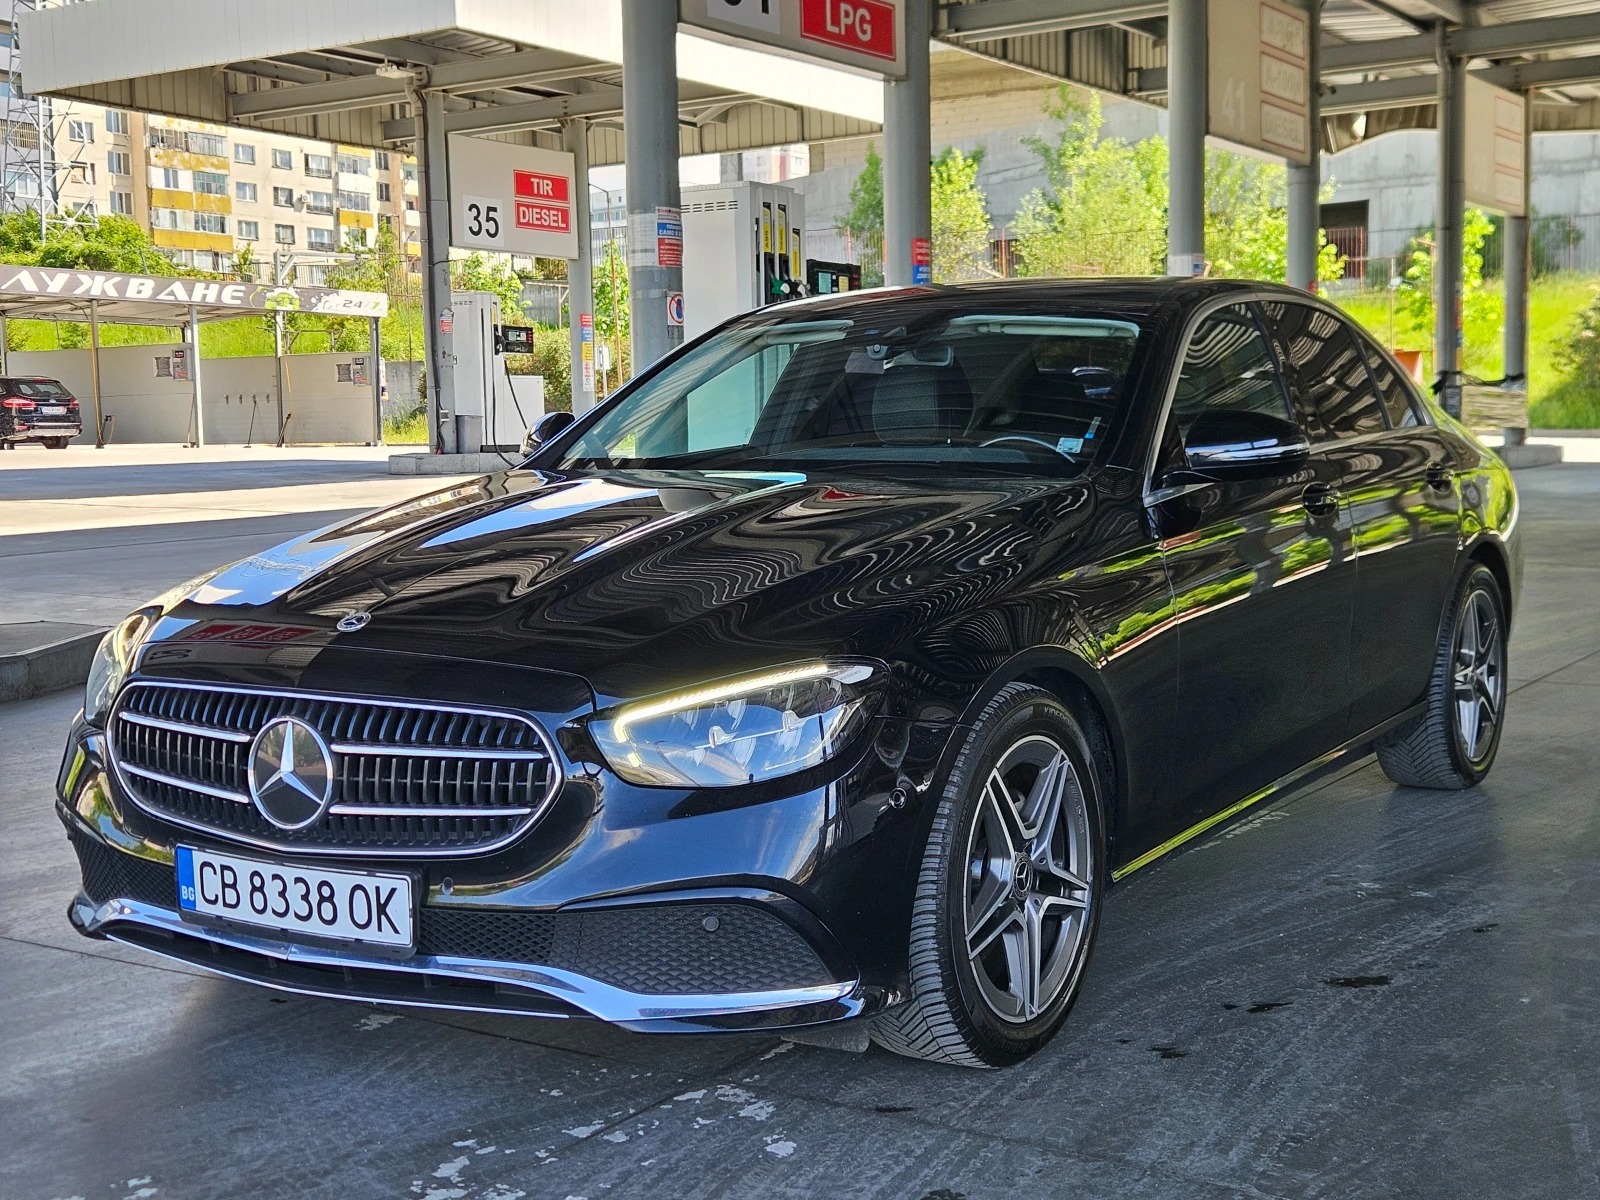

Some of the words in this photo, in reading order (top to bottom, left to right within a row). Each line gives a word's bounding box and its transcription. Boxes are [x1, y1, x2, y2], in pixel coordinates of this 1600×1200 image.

[826, 0, 872, 42] LPG
[530, 177, 553, 197] TIR
[468, 203, 499, 239] 35
[519, 206, 566, 228] DIESEL
[182, 885, 195, 901] BG
[199, 860, 241, 910] CB
[249, 869, 339, 926] 8338
[348, 883, 402, 935] OK
